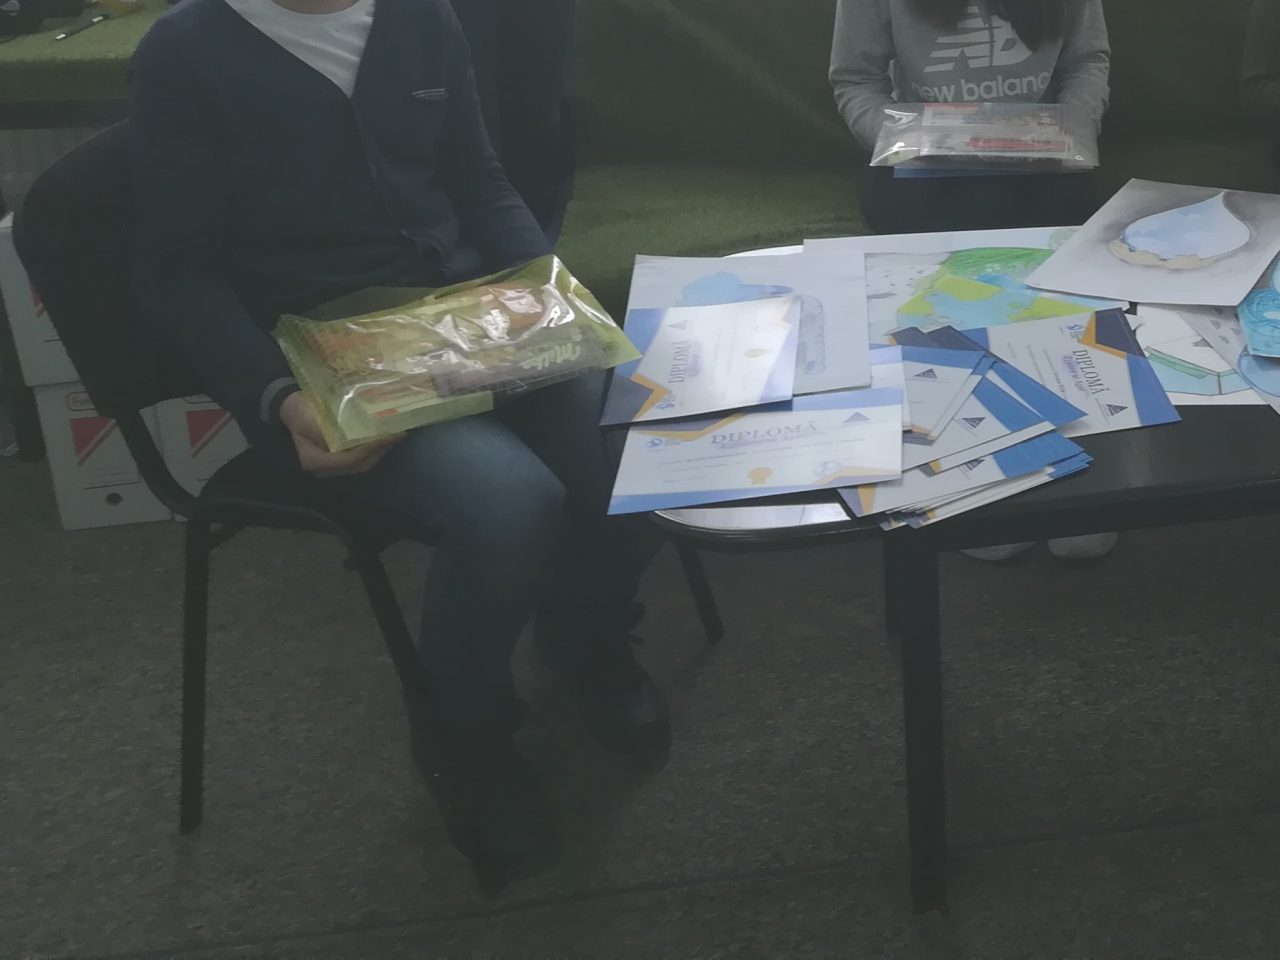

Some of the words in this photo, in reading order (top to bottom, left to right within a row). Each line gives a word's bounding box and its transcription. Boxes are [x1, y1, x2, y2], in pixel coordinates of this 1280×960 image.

[911, 80, 957, 103] new
[960, 71, 1052, 101] balanc
[520, 339, 583, 372] Milka
